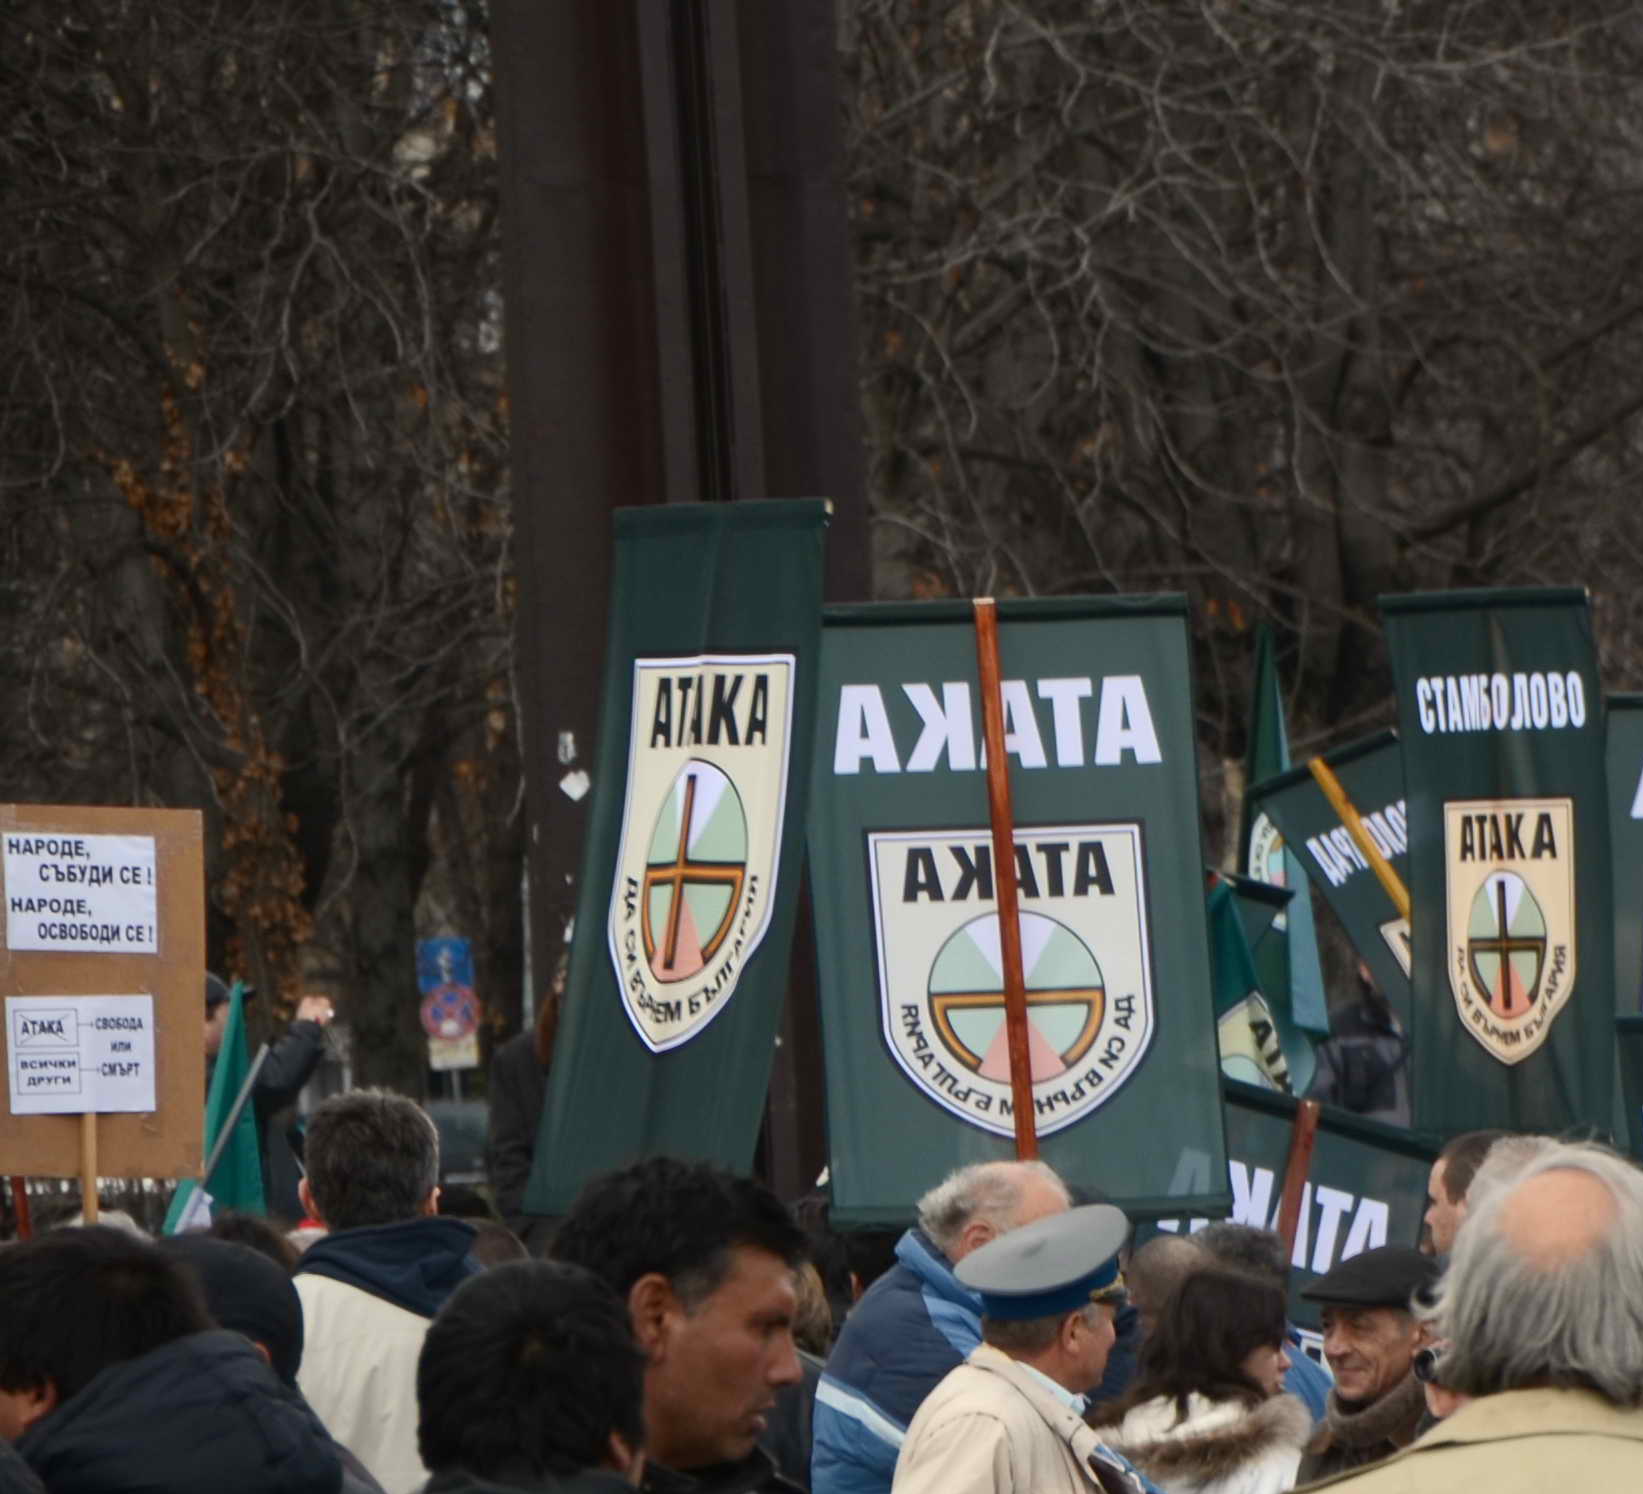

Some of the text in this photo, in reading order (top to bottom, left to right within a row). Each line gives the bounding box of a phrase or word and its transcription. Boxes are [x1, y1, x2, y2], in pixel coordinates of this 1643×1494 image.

[650, 674, 768, 748] АТАКА
[1417, 671, 1586, 734] СТАМБОЛОВО
[1460, 813, 1557, 862] АТАКА
[8, 839, 91, 860] НАРОДЕ,
[39, 864, 113, 887] СЪБУДИ
[119, 866, 142, 885] СЕ
[11, 897, 92, 917] НАРОДЕ,
[38, 923, 120, 944] ОСВОБОДИ
[125, 925, 145, 942] СЕ
[21, 1020, 64, 1036] АТАКА
[95, 1017, 144, 1032] СВОБОДА
[110, 1041, 132, 1053] ИЛИ
[20, 1060, 77, 1070] ВСИЧКИ
[101, 1063, 141, 1077] СМЪРТ
[27, 1076, 72, 1087] ДРУГИ
